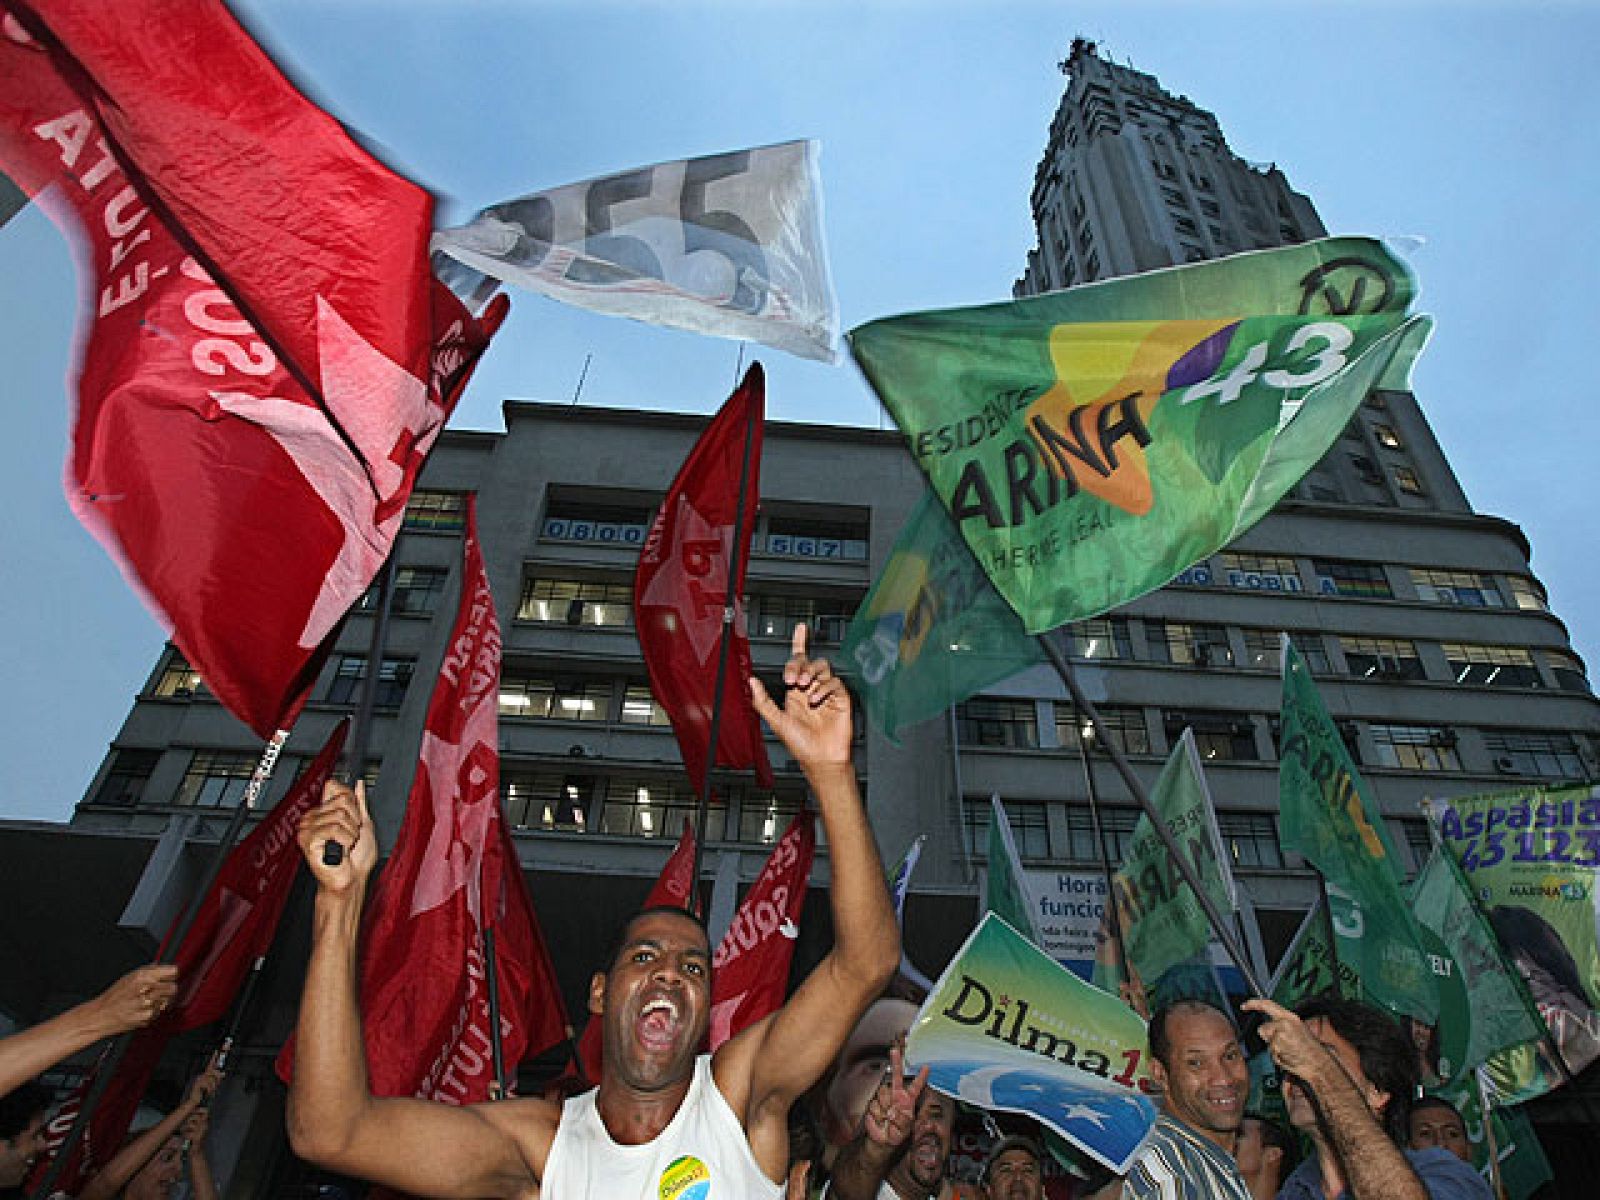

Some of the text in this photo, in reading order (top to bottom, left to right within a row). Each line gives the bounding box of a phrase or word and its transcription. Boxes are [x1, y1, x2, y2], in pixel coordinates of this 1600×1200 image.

[1179, 321, 1355, 406] 43
[549, 522, 641, 542] 0800
[942, 974, 1111, 1078] Dilma
